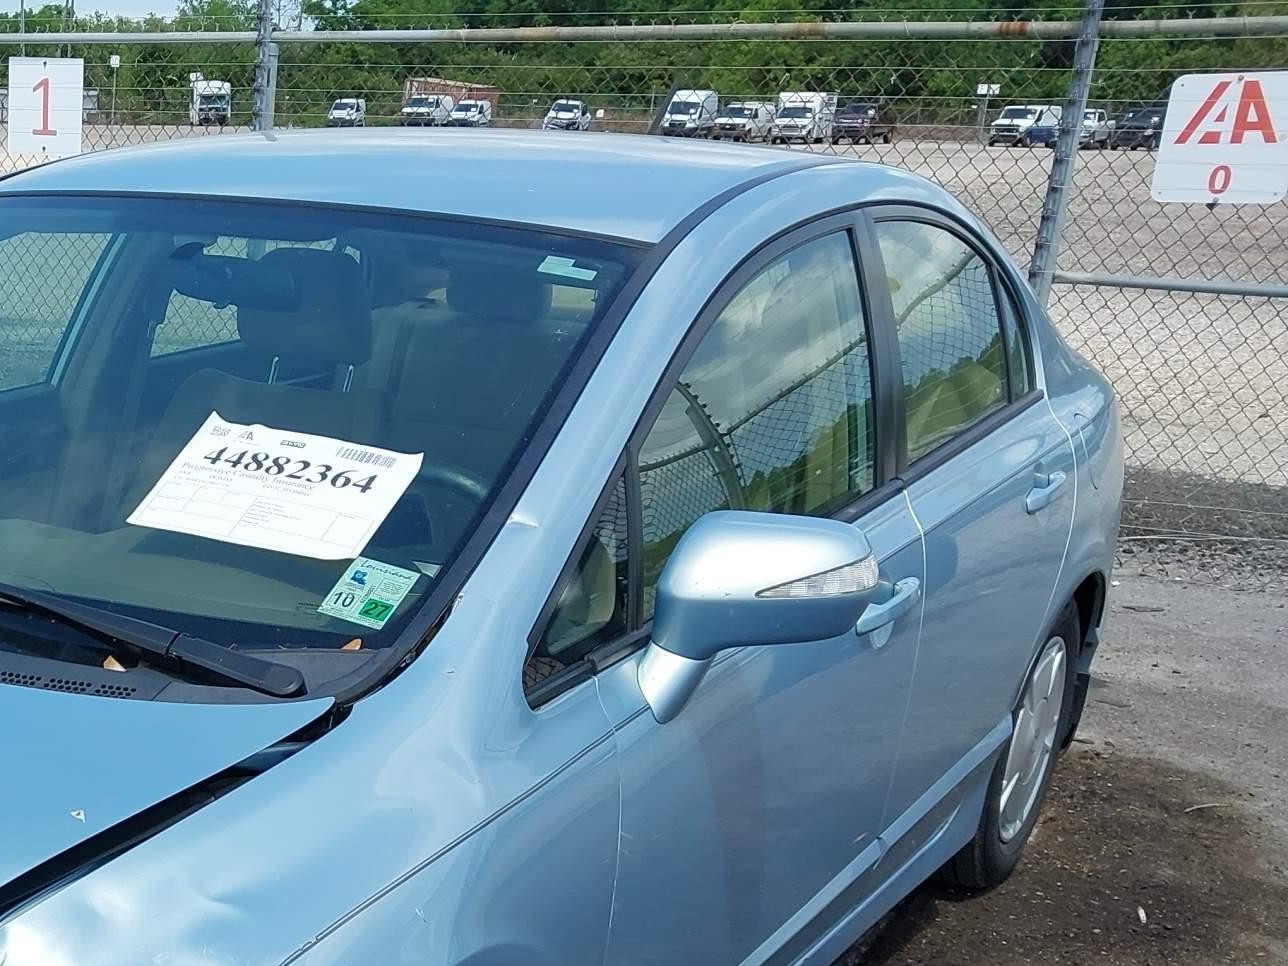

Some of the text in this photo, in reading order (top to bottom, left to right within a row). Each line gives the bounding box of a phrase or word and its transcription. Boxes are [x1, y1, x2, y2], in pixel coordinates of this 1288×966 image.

[32, 77, 57, 136] 1
[1208, 165, 1232, 194] 0
[203, 446, 378, 494] 44882364
[334, 591, 355, 608] 10
[364, 601, 390, 619] 27
